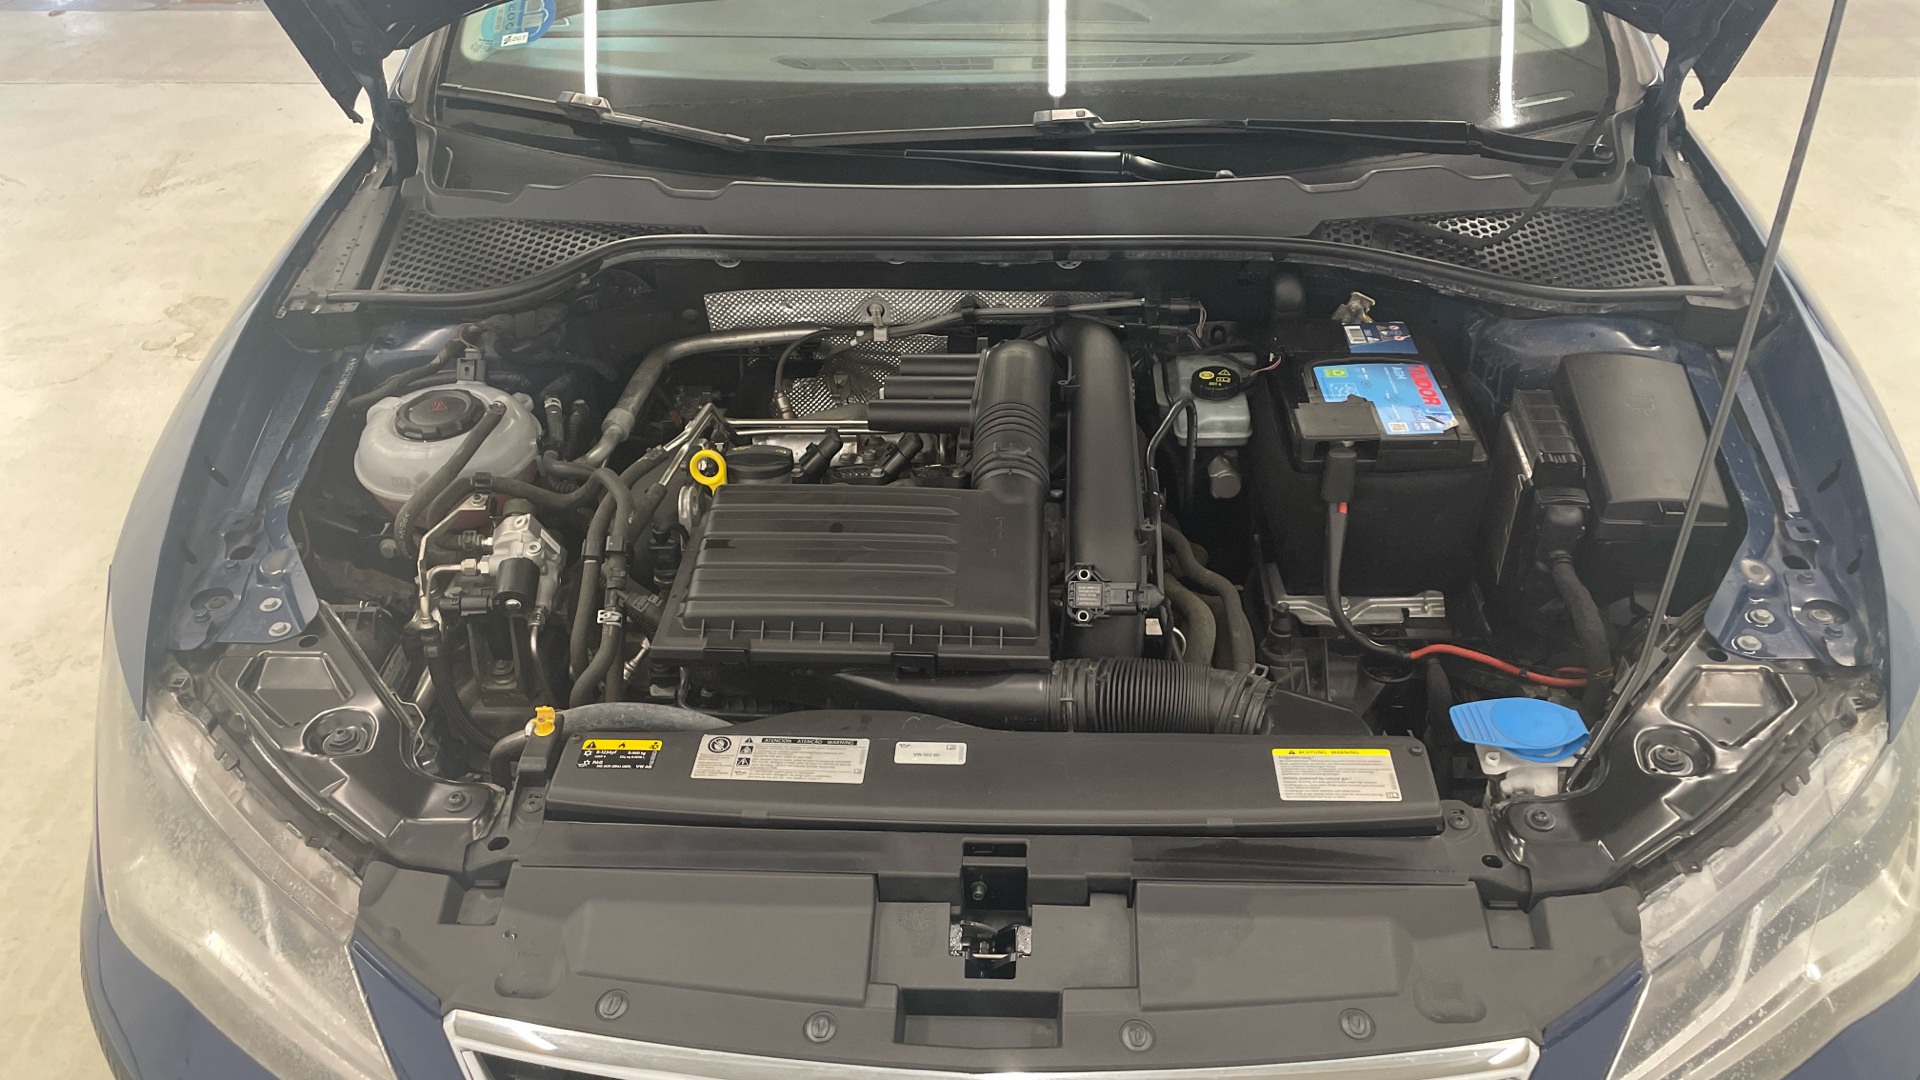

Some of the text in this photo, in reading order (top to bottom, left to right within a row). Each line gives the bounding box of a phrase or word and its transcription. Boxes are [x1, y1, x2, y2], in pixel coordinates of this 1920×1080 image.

[505, 3, 516, 31] ECO
[512, 34, 527, 42] DGT
[1407, 364, 1441, 406] TUDOR
